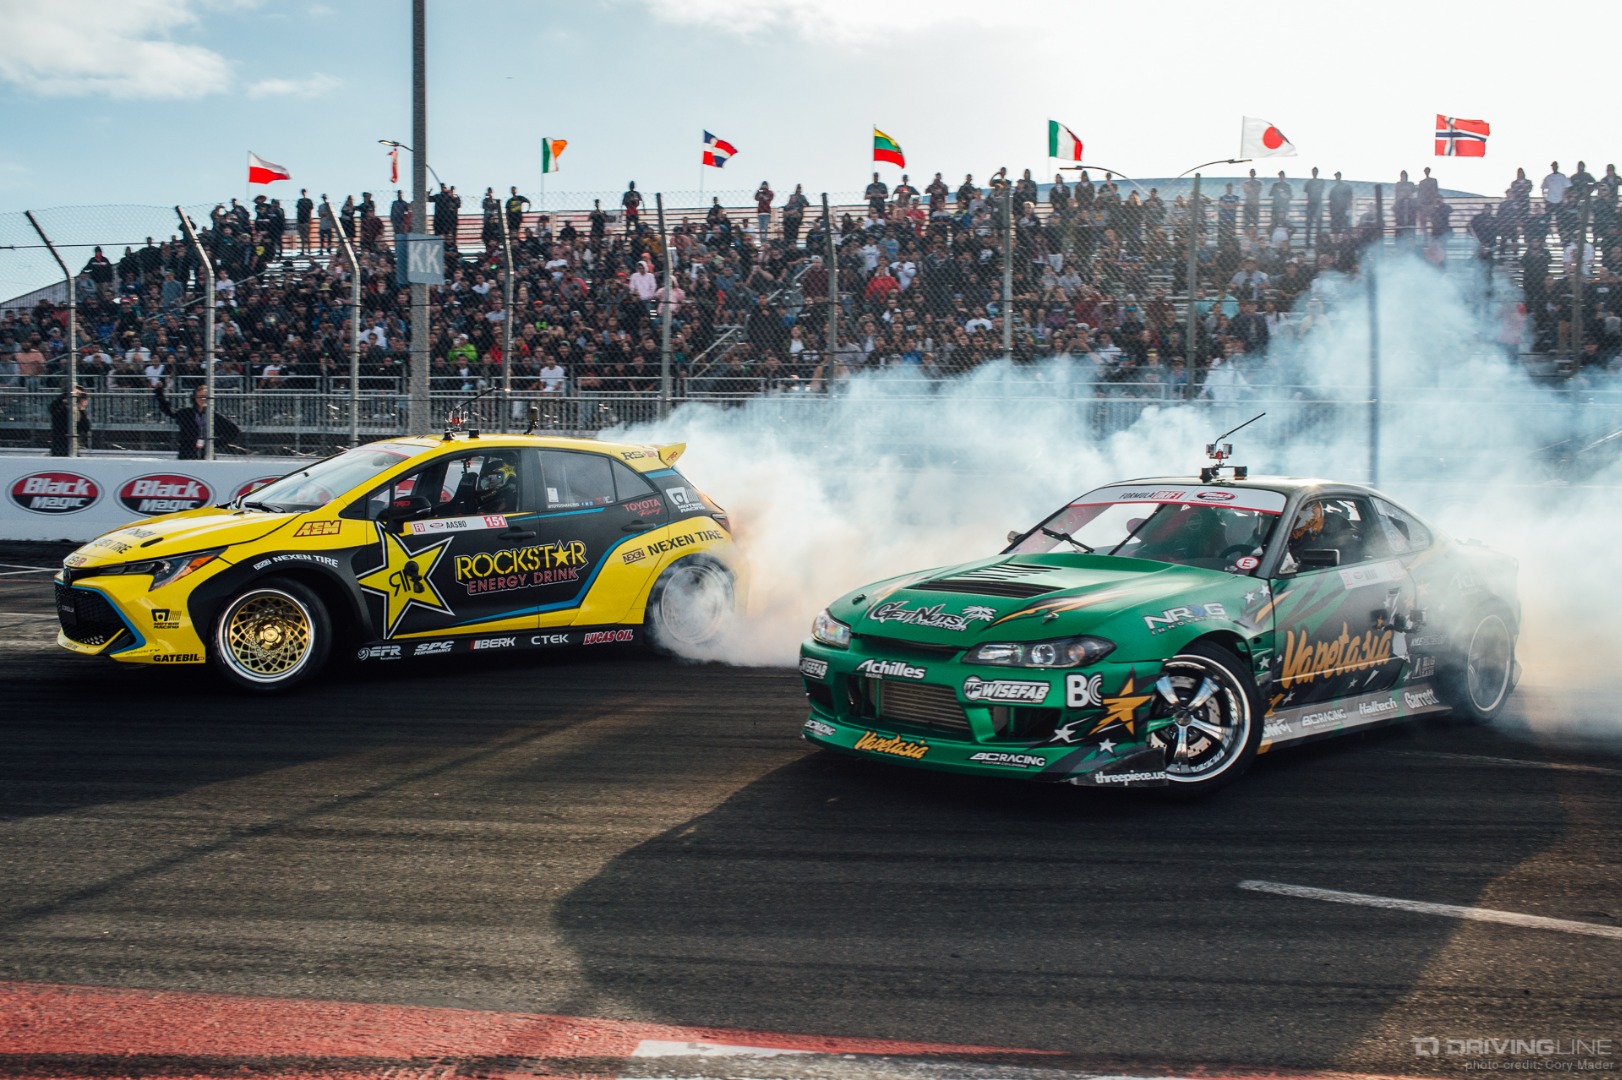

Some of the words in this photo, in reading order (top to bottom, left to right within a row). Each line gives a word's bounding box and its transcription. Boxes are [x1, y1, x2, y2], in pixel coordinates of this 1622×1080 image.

[409, 241, 440, 274] KK
[23, 477, 90, 496] Black
[130, 480, 199, 498] Black
[31, 496, 89, 509] Magic
[623, 499, 661, 512] TOYOTA
[293, 520, 342, 537] AEM
[446, 520, 467, 530] AASBO
[485, 516, 507, 527] 151
[647, 534, 696, 557] NEXEN
[696, 529, 724, 542] TIRE
[272, 553, 312, 563] NEXEN
[313, 554, 339, 568] TIRE
[456, 541, 586, 580] ROCKSTAR
[468, 573, 528, 594] ENERGY
[533, 567, 578, 584] DRINK
[479, 637, 517, 650] BERK
[531, 634, 569, 646] CTEK
[583, 630, 615, 645] LUCAS
[616, 629, 634, 642] OIL
[370, 645, 401, 657] EFR
[415, 640, 455, 651] SPC
[153, 653, 199, 662] GATEBIL
[1281, 621, 1394, 689] Vapetasia
[856, 659, 927, 679] Achilles
[982, 683, 1050, 699] WISEFAB
[1404, 688, 1440, 709] Garrett
[1359, 698, 1398, 715] Haltech
[854, 730, 930, 759] Vapetasia
[1095, 770, 1166, 785] threepiece.us
